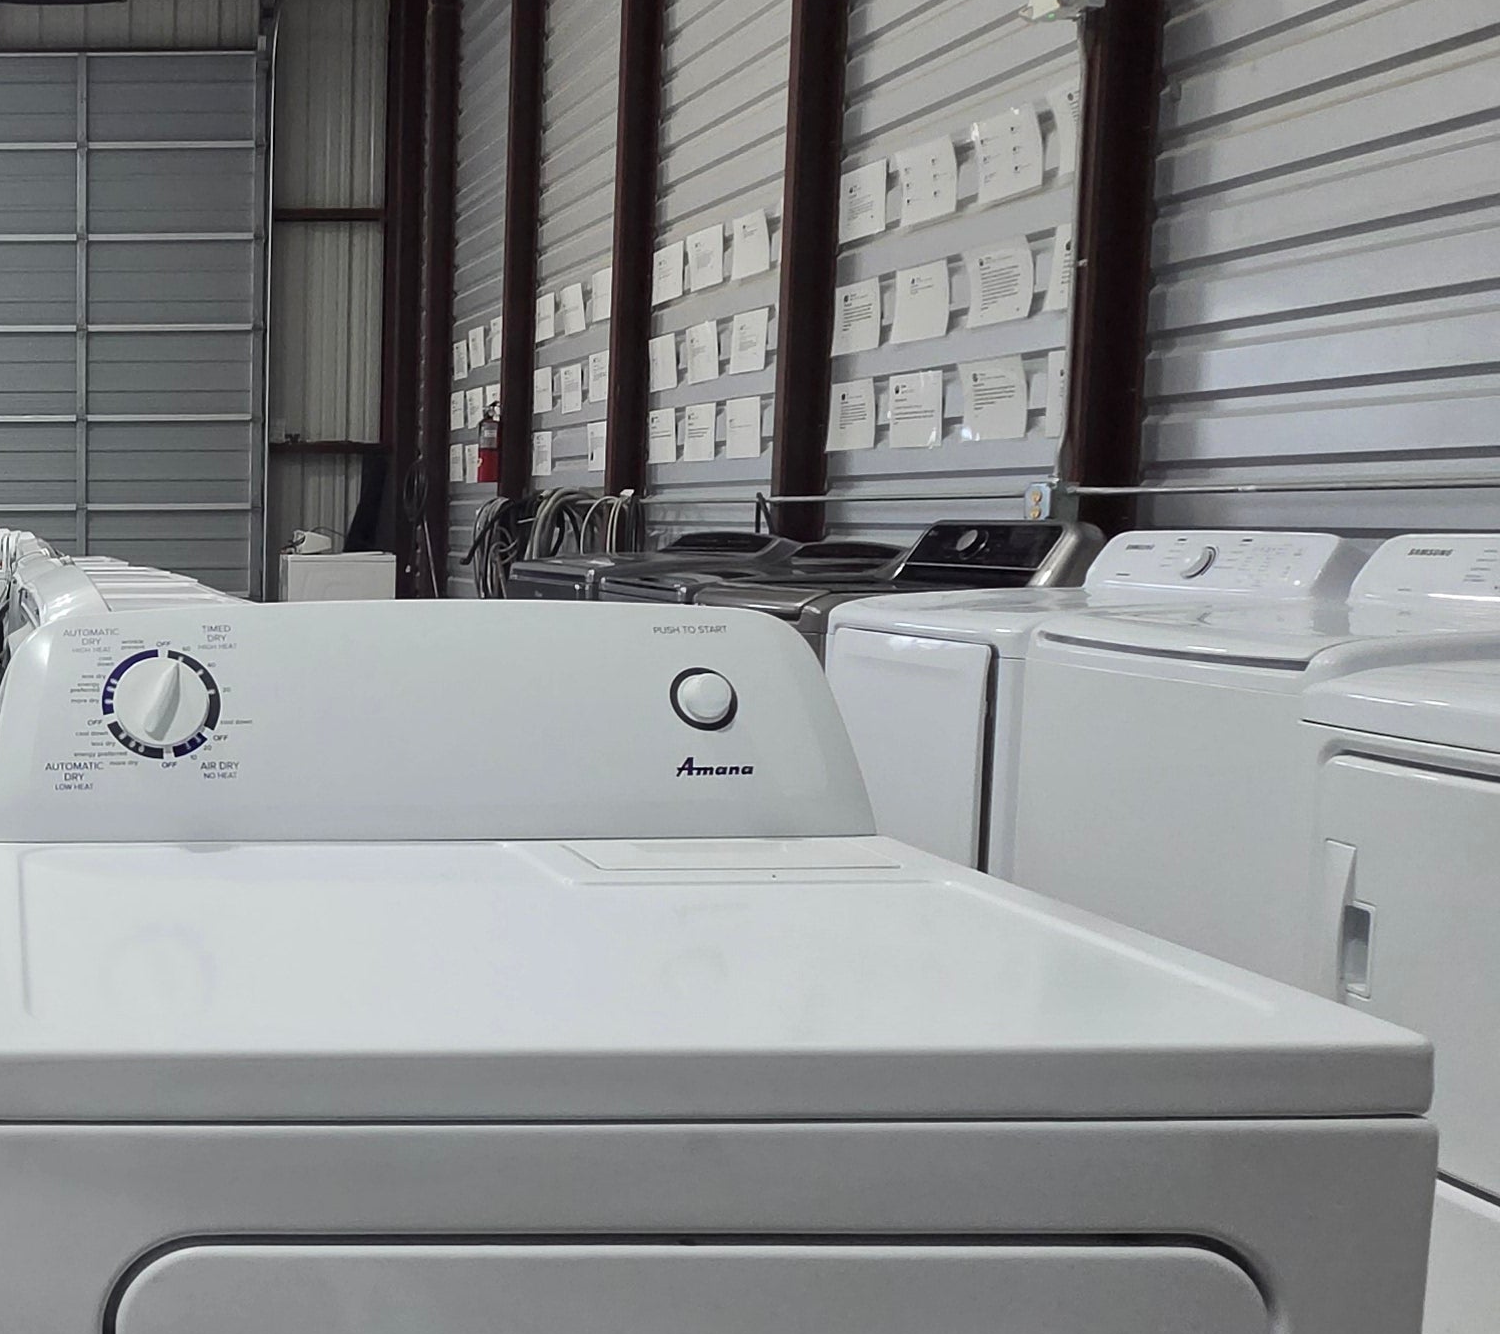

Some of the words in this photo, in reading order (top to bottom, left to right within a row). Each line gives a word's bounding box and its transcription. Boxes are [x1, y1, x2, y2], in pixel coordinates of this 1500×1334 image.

[63, 628, 119, 637] AUTOMATIC
[202, 625, 231, 633] TIMED
[653, 626, 680, 634] PUSH
[682, 625, 696, 634] TO
[697, 625, 727, 633] START
[81, 637, 102, 646] DRY
[207, 634, 227, 642] DRY
[87, 719, 103, 727] OFF
[212, 734, 228, 742] OFF
[45, 762, 104, 771] AUTOMATIC
[200, 762, 217, 770] AIR
[219, 761, 240, 770] DRY
[676, 757, 754, 777] Amana
[64, 773, 84, 781] DRY
[218, 771, 237, 779] HEAT
